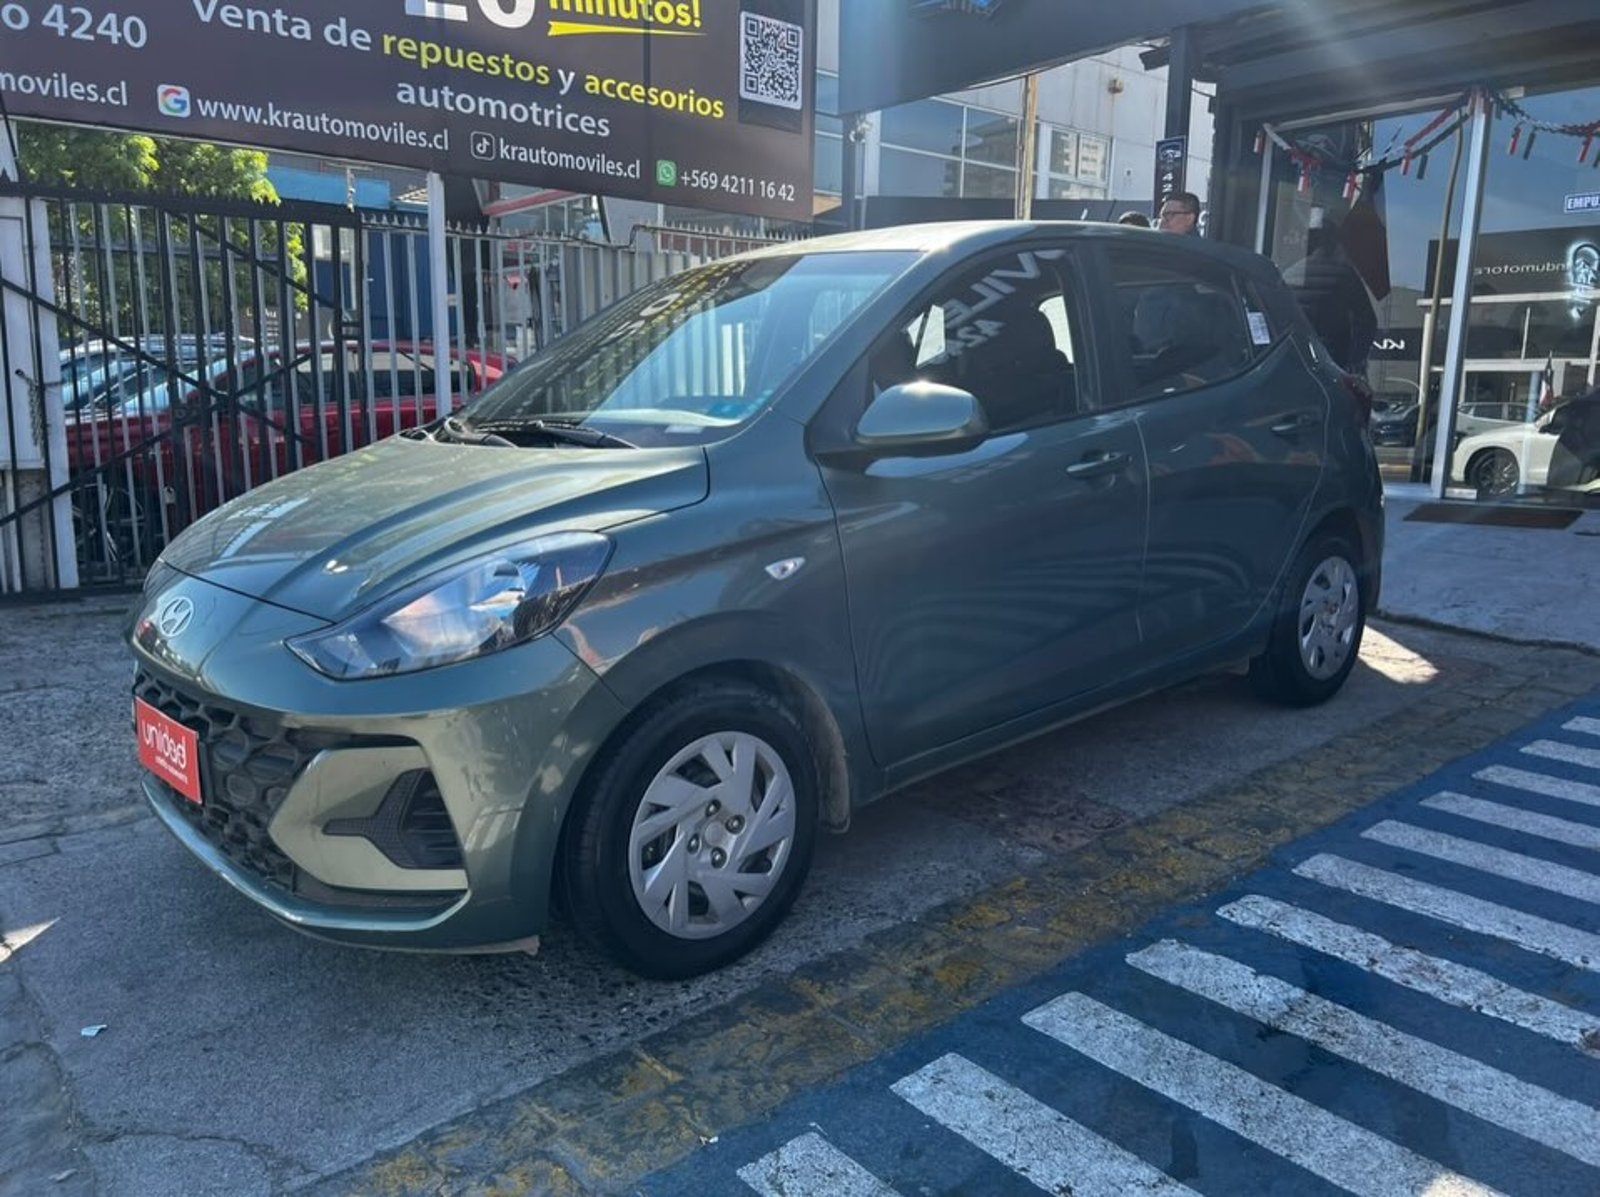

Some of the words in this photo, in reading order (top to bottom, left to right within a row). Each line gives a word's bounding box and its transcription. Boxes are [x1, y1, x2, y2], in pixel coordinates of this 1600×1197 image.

[42, 4, 148, 49] 4240
[193, 0, 312, 41] Venta
[323, 17, 372, 51] de
[382, 33, 550, 85] repuestos
[557, 69, 576, 94] y
[584, 73, 725, 119] accesorios
[197, 98, 450, 151] www.krautomoviles.cl
[396, 82, 611, 137] automotrices
[500, 138, 641, 180] krautomoviles.cl
[680, 169, 718, 190] +569
[721, 174, 754, 196] 4211
[760, 180, 776, 199] 16
[778, 183, 795, 202] 42
